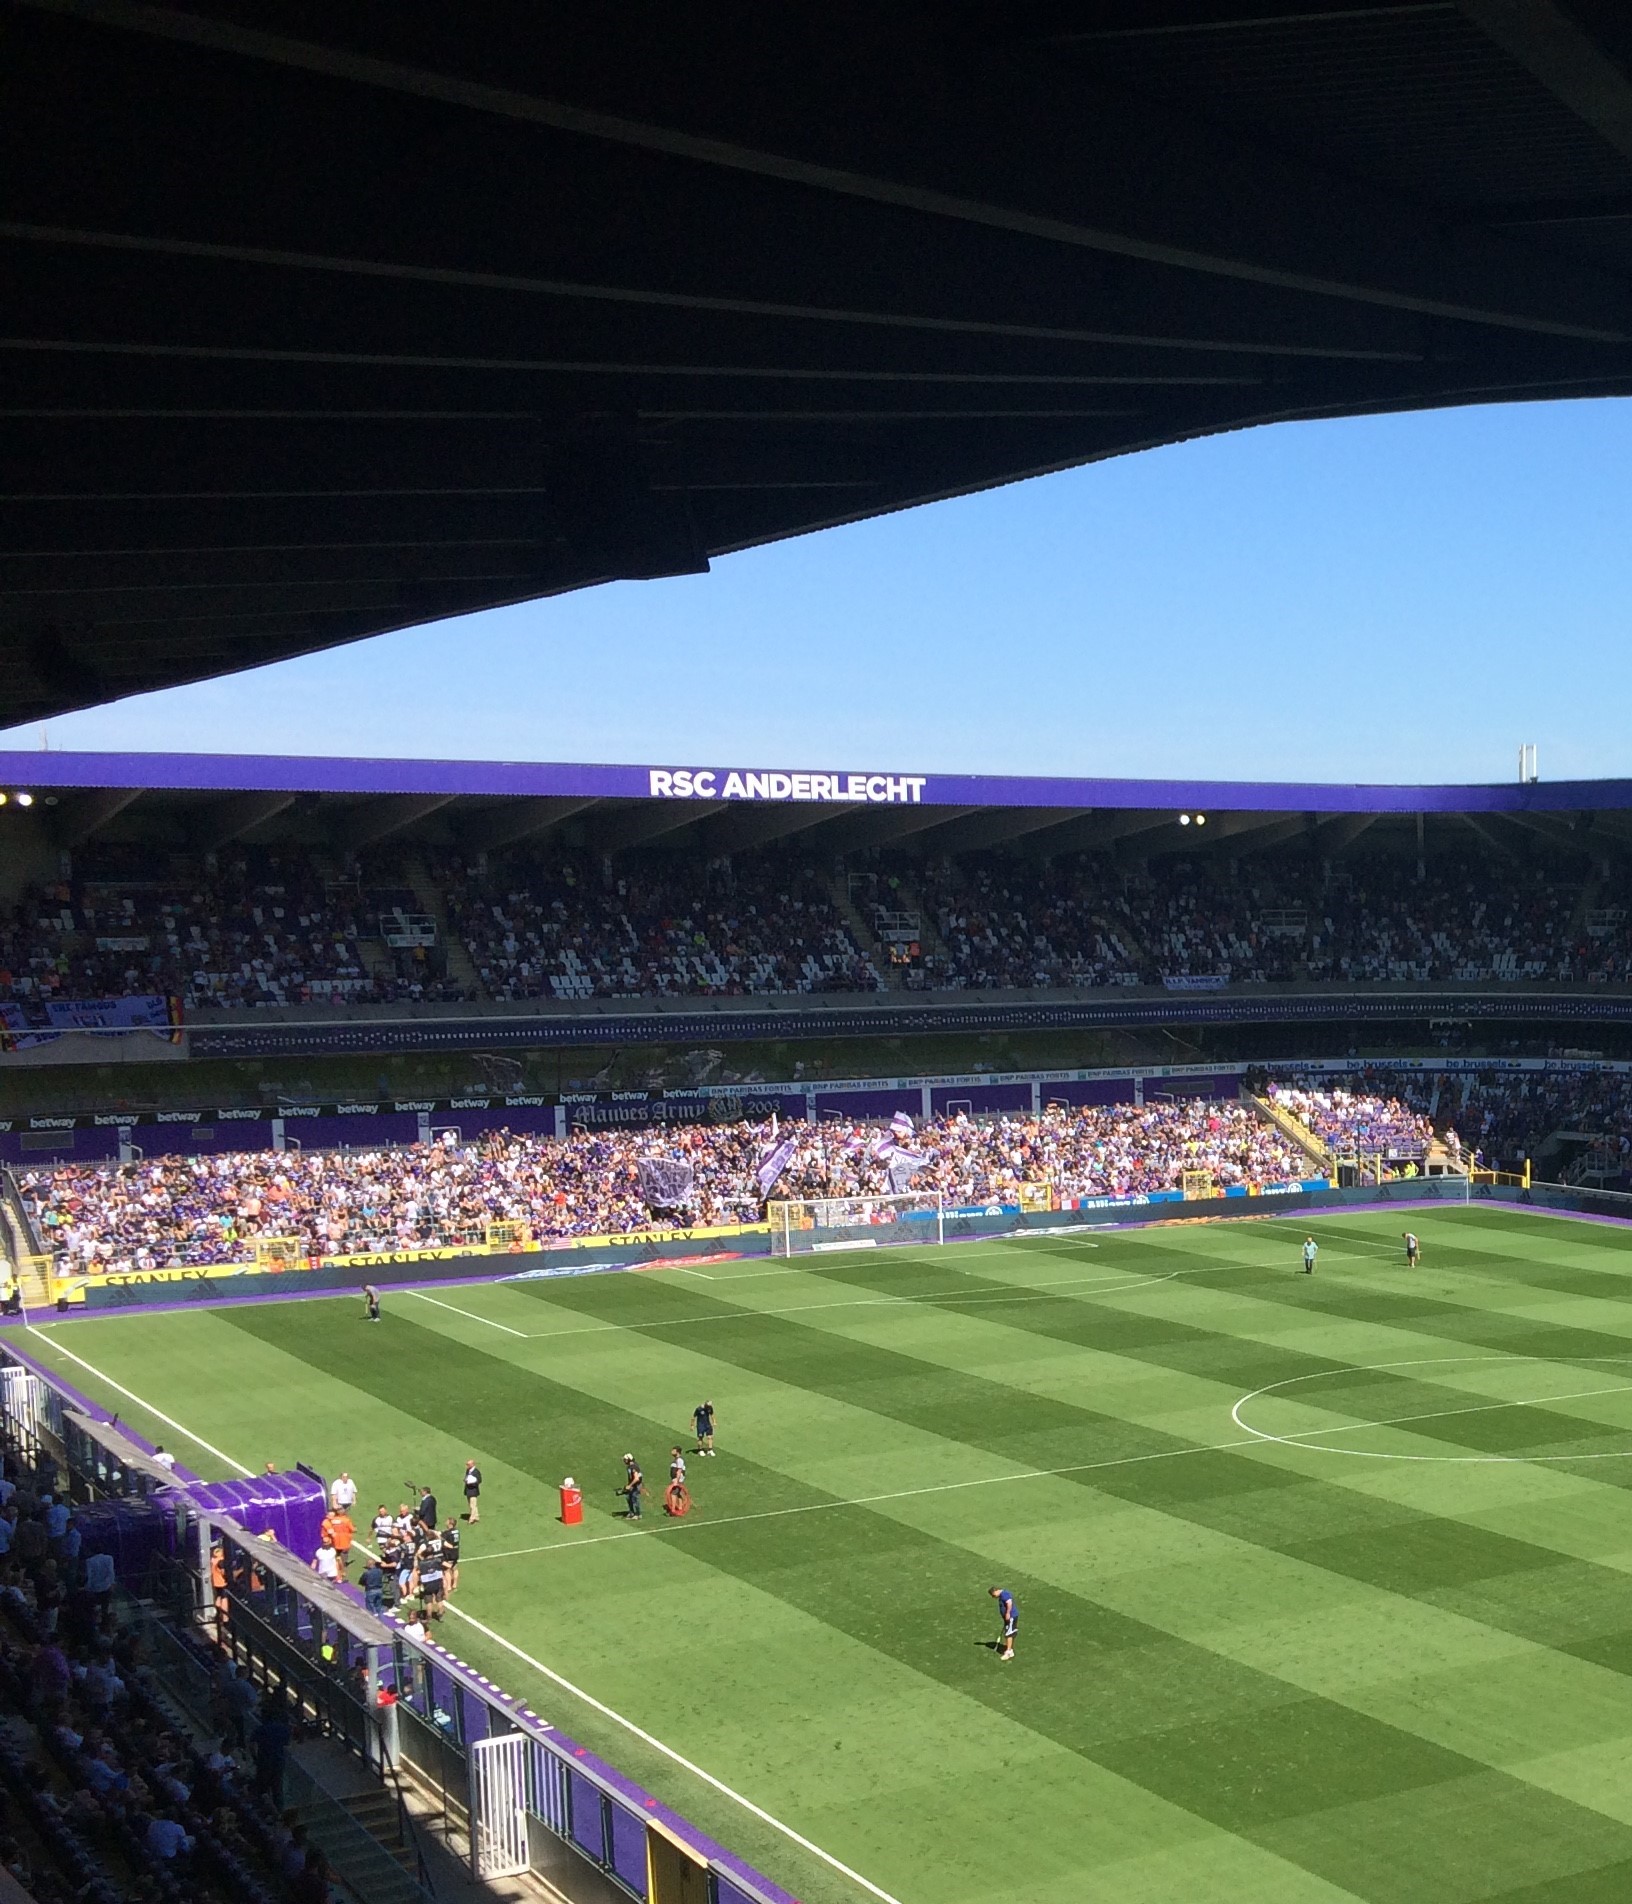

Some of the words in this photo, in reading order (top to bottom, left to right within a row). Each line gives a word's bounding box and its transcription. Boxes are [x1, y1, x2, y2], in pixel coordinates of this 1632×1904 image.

[650, 770, 717, 798] RSC
[722, 772, 927, 802] ANDERLECHT
[1346, 1060, 1408, 1069] be.brussels
[1446, 1060, 1507, 1069] be.brussels
[711, 1087, 728, 1095] BNP
[730, 1085, 763, 1094] PARIBAS
[764, 1084, 792, 1093] FORTIS
[830, 1081, 861, 1089] PARIBAS
[862, 1080, 889, 1088] FORTIS
[30, 1118, 76, 1129] betway
[94, 1115, 139, 1126] betway
[157, 1112, 201, 1123] betway
[218, 1109, 261, 1120] betway
[278, 1107, 320, 1117] betway
[337, 1104, 378, 1114] betway
[394, 1101, 435, 1112] betway
[451, 1098, 490, 1109] betway
[505, 1096, 544, 1106] betway
[559, 1093, 597, 1103] betway
[612, 1091, 648, 1101] betway
[663, 1088, 699, 1099] betway
[574, 1105, 649, 1123] Mauves
[652, 1102, 706, 1120] Army
[747, 1100, 780, 1114] 2003
